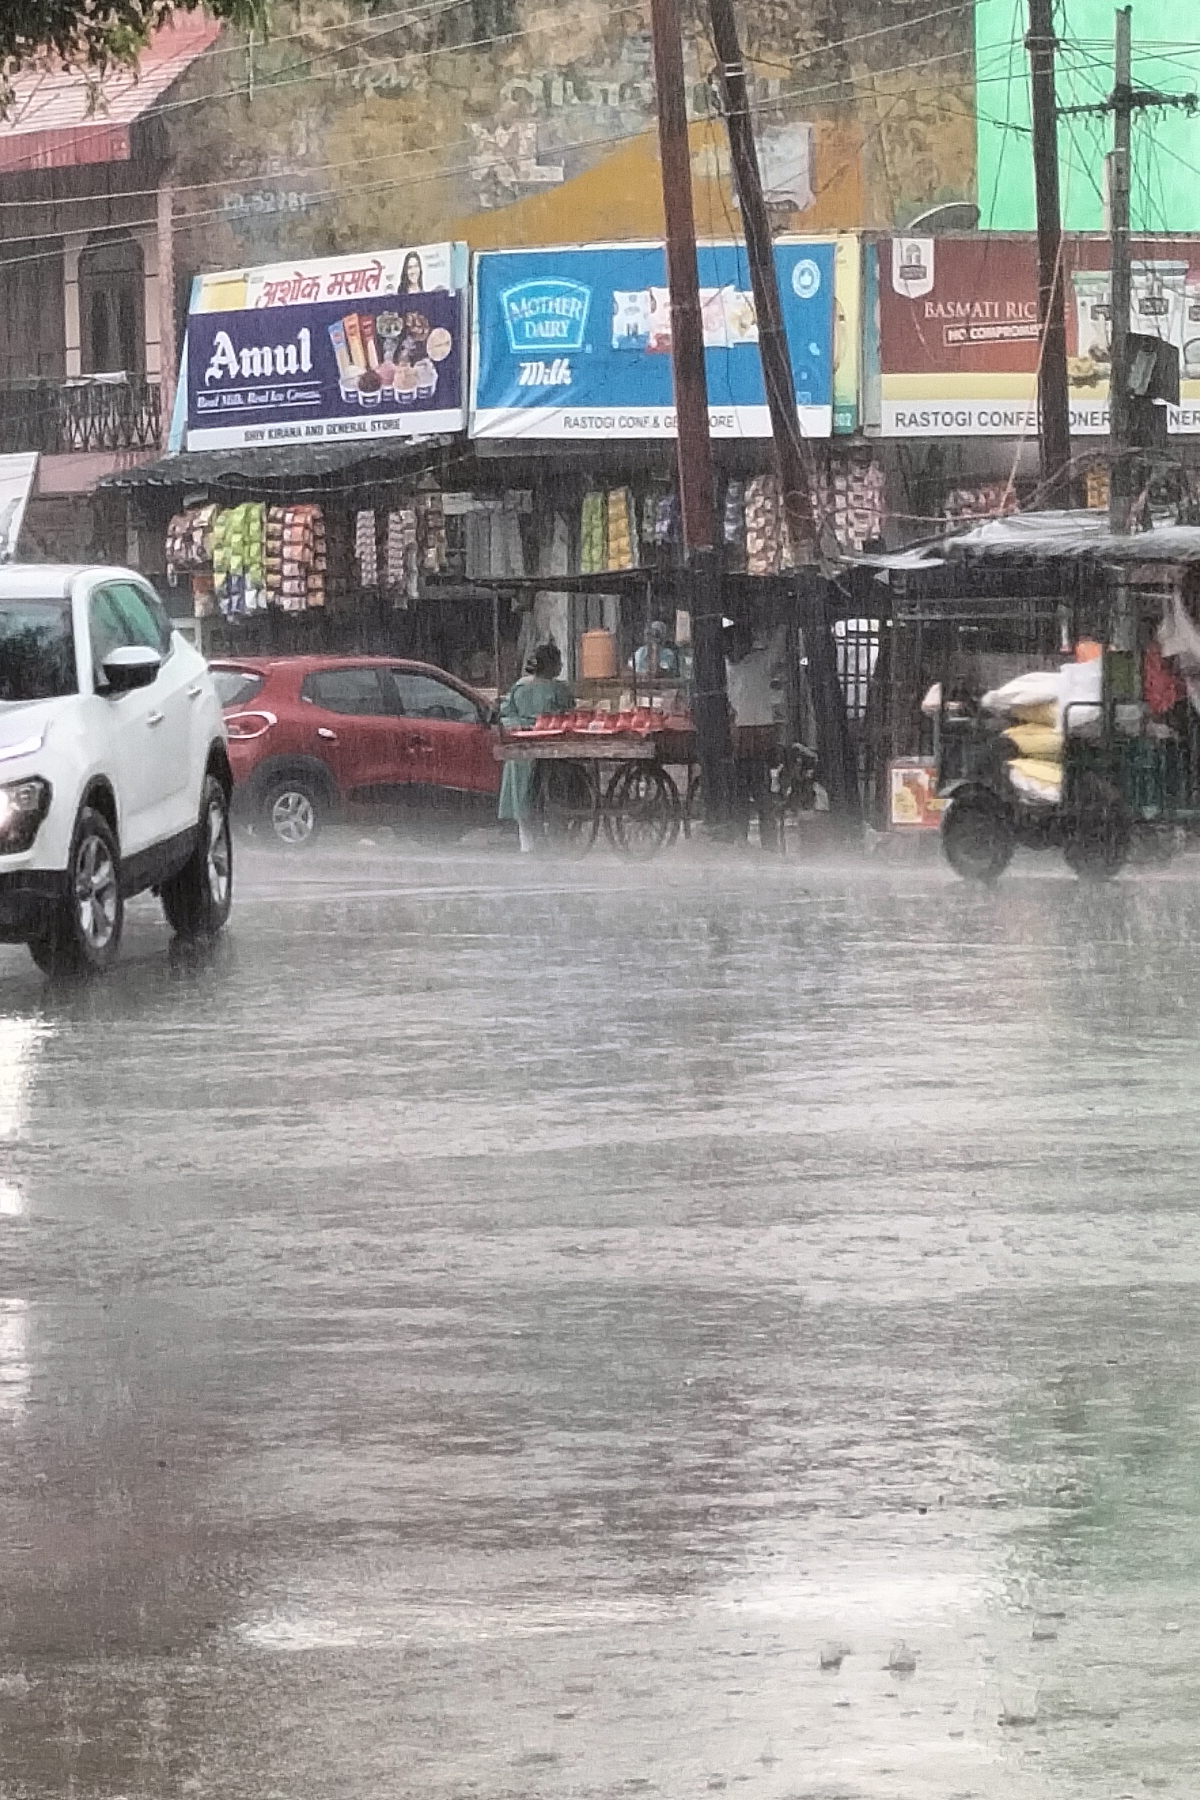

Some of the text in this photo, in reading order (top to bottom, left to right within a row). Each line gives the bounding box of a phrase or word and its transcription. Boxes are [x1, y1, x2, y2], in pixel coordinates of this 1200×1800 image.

[256, 260, 385, 308] अशोक मसाले
[510, 297, 582, 321] MOTHER
[924, 301, 999, 318] BASMATI
[524, 320, 570, 338] DAIRY
[204, 327, 313, 387] Amul
[519, 359, 573, 385] Milk
[563, 415, 615, 429] RASTOGI
[895, 411, 973, 428] RASTOGI
[305, 424, 324, 437] AND
[326, 422, 368, 435] GENERAL
